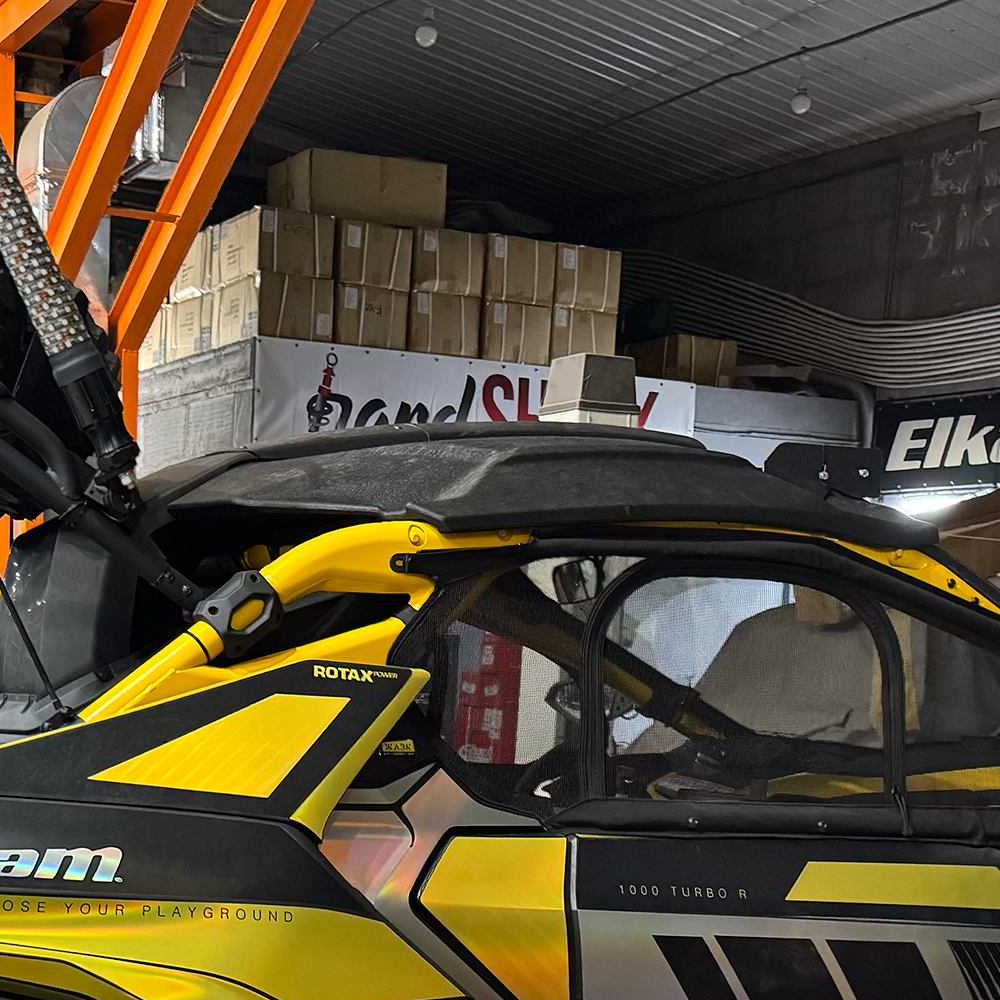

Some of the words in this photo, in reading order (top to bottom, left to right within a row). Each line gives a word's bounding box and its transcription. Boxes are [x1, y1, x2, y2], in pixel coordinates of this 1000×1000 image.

[313, 664, 374, 683] ROTAX
[373, 670, 398, 679] POWER
[619, 884, 659, 896] 1000
[670, 885, 728, 899] TURBO
[738, 888, 748, 899] R
[65, 901, 126, 916] YOUR
[142, 905, 295, 923] PLAYGROUND
